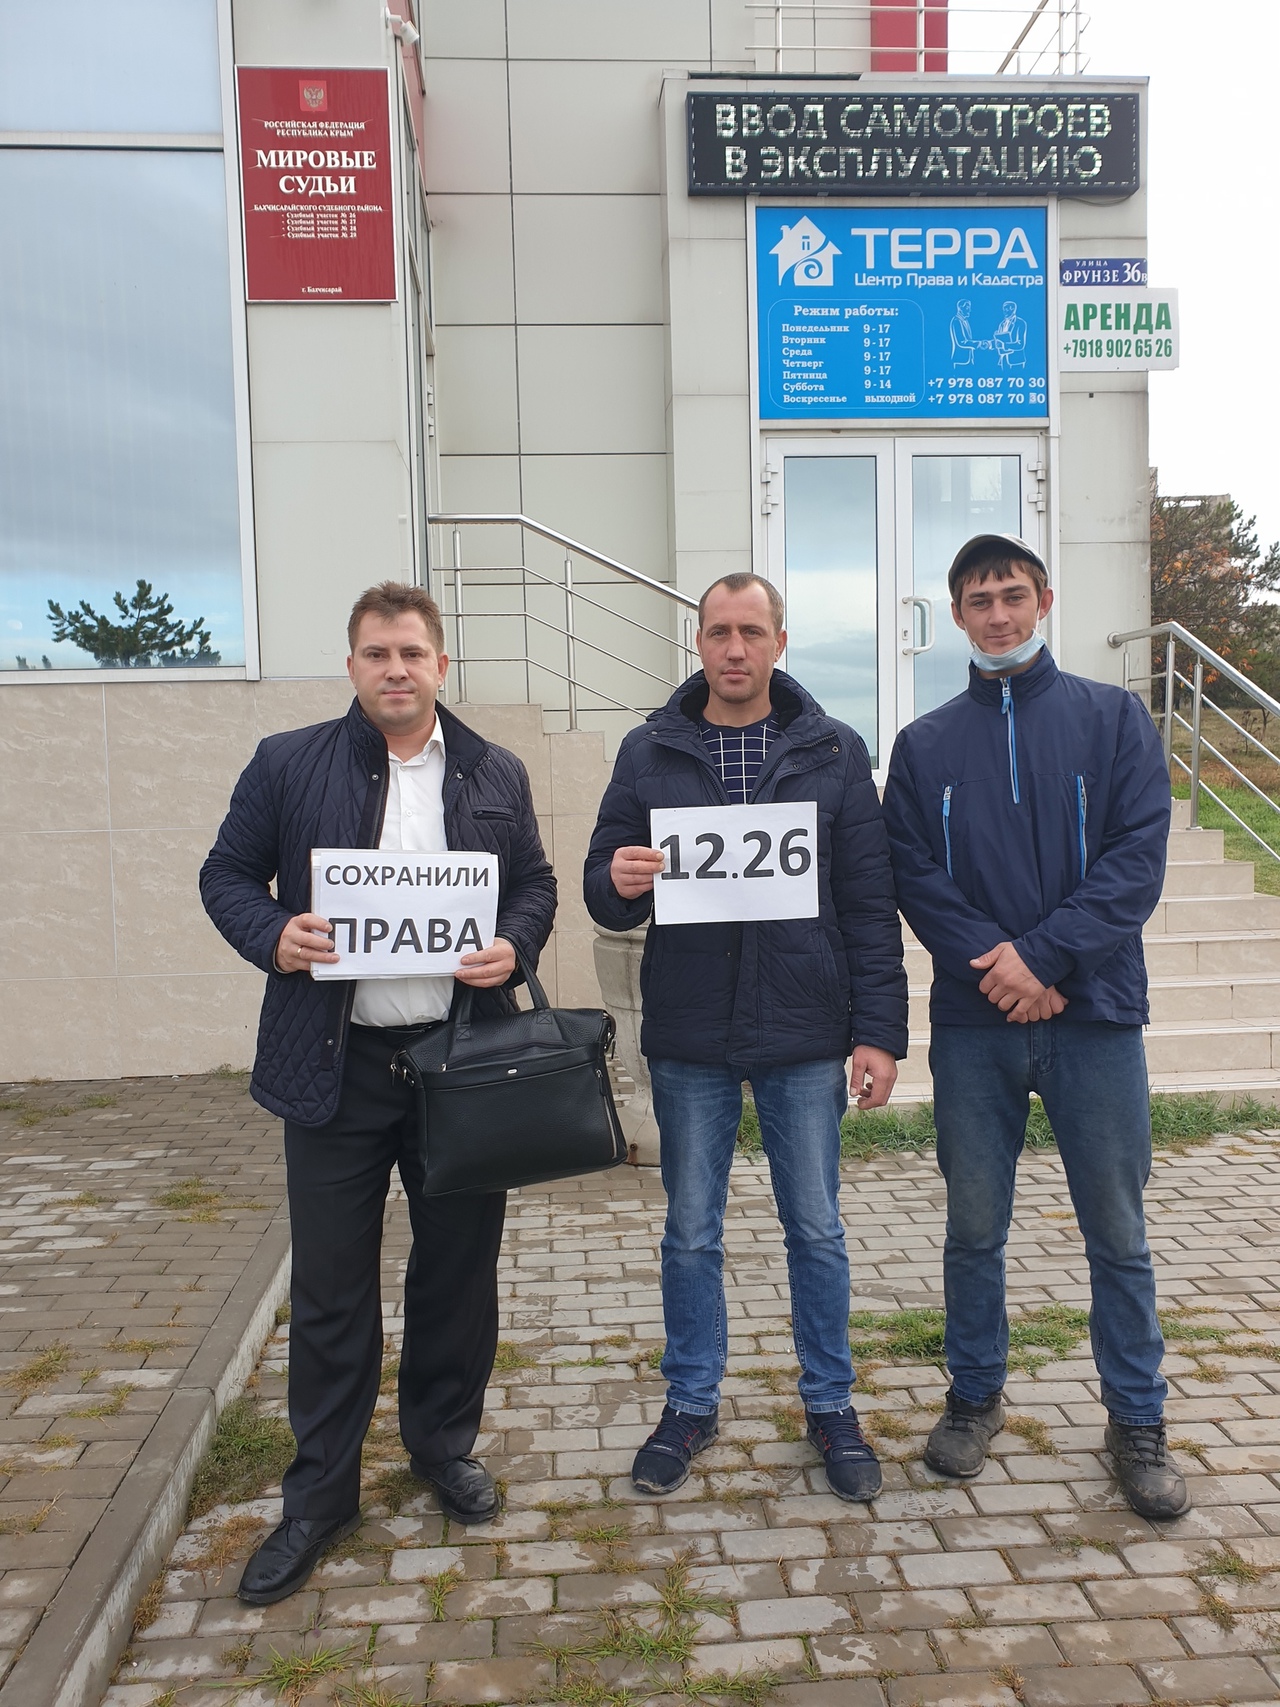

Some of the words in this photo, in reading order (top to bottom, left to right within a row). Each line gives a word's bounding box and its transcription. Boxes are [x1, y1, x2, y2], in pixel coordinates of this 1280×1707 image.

[264, 120, 317, 129] РОССИЙСКАЯ
[318, 121, 365, 130] ФЕДЕРАЦИЯ
[715, 104, 828, 139] ВВОД
[840, 104, 1112, 139] САМОСТРОЕВ
[276, 129, 328, 137] РЕСПУБЛИКА
[330, 129, 354, 138] КРЫМ
[256, 150, 377, 169] МИРОВЫЕ
[725, 146, 748, 179] В
[760, 145, 1102, 180] ЭКСПЛУАТАЦИЮ
[279, 175, 357, 198] СУДЬИ
[851, 227, 1038, 269] ТЕРРА
[855, 273, 901, 288] Центр
[906, 273, 954, 288] Права
[958, 275, 967, 285] и
[972, 273, 1043, 288] Кадастра
[1062, 270, 1119, 284] ФРУНЗЕ
[794, 305, 840, 316] Режим
[844, 304, 899, 318] работы:
[1064, 303, 1172, 334] АРЕНДА
[782, 324, 850, 333] Понедельник
[782, 336, 826, 346] Вторник
[1063, 339, 1103, 358] +7918
[1106, 339, 1132, 357] 902
[1135, 339, 1152, 357] 65
[1155, 338, 1172, 357] 26
[782, 348, 813, 357] Среда
[782, 359, 824, 369] Четверг
[783, 371, 827, 380] Пятница
[783, 382, 824, 393] Суббота
[928, 378, 944, 388] +7
[948, 378, 973, 388] 978
[978, 378, 1003, 388] 087
[1008, 378, 1024, 388] 70
[1029, 378, 1045, 388] 30
[783, 395, 847, 404] Воскресенье
[865, 393, 916, 404] выходной
[928, 393, 944, 404] +7
[948, 393, 973, 404] 978
[978, 393, 1003, 404] 087
[1008, 393, 1024, 404] 70
[1029, 392, 1045, 404] 30
[659, 828, 811, 881] 12.26
[325, 864, 489, 887] СОХРАНИЛИ
[327, 917, 484, 954] ПРАВА
